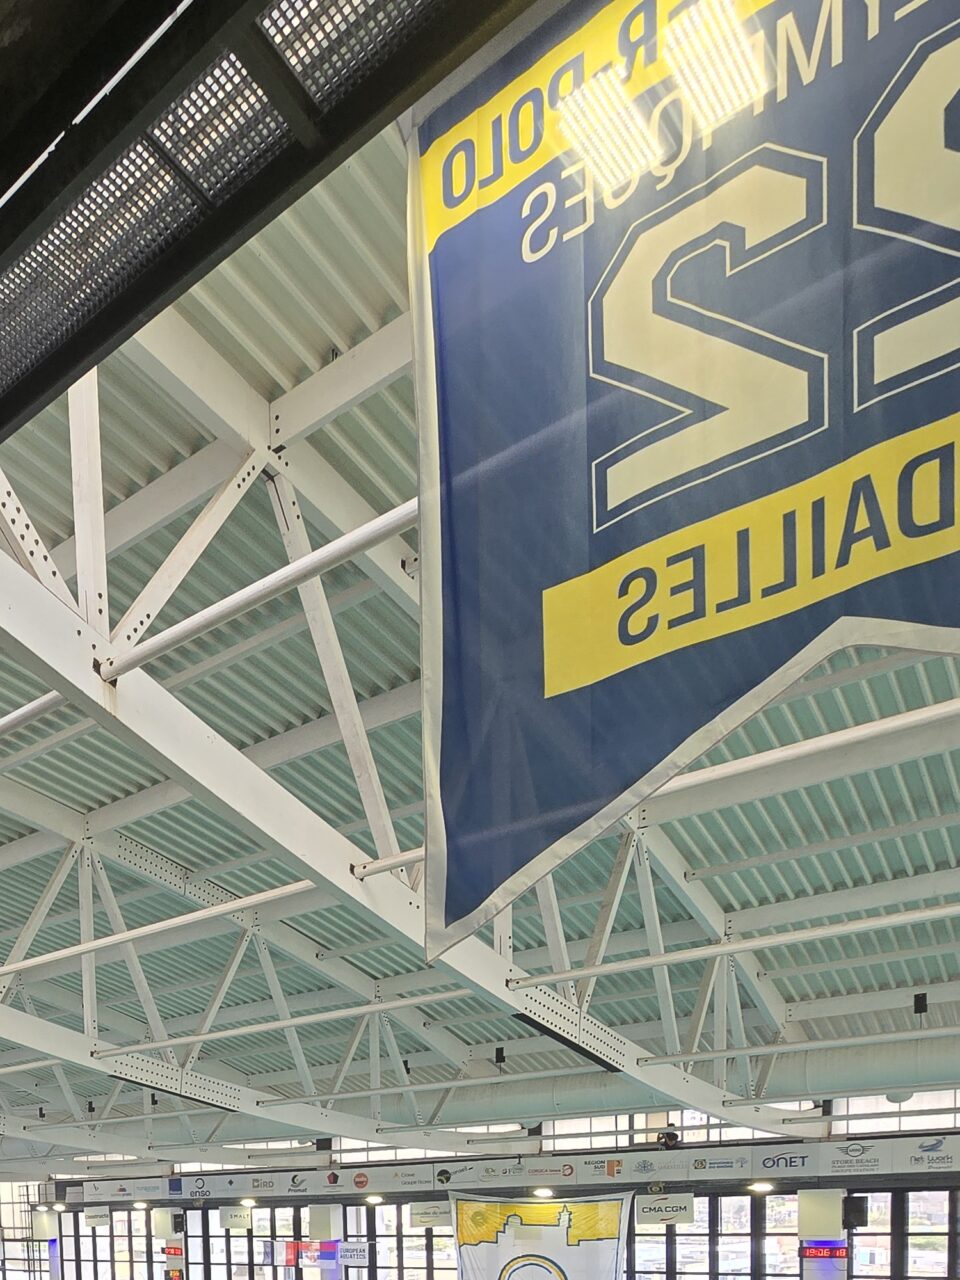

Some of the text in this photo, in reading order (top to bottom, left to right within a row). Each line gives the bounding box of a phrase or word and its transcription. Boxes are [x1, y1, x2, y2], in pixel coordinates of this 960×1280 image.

[189, 1189, 211, 1197] enso
[641, 1205, 688, 1214] CMA CGM
